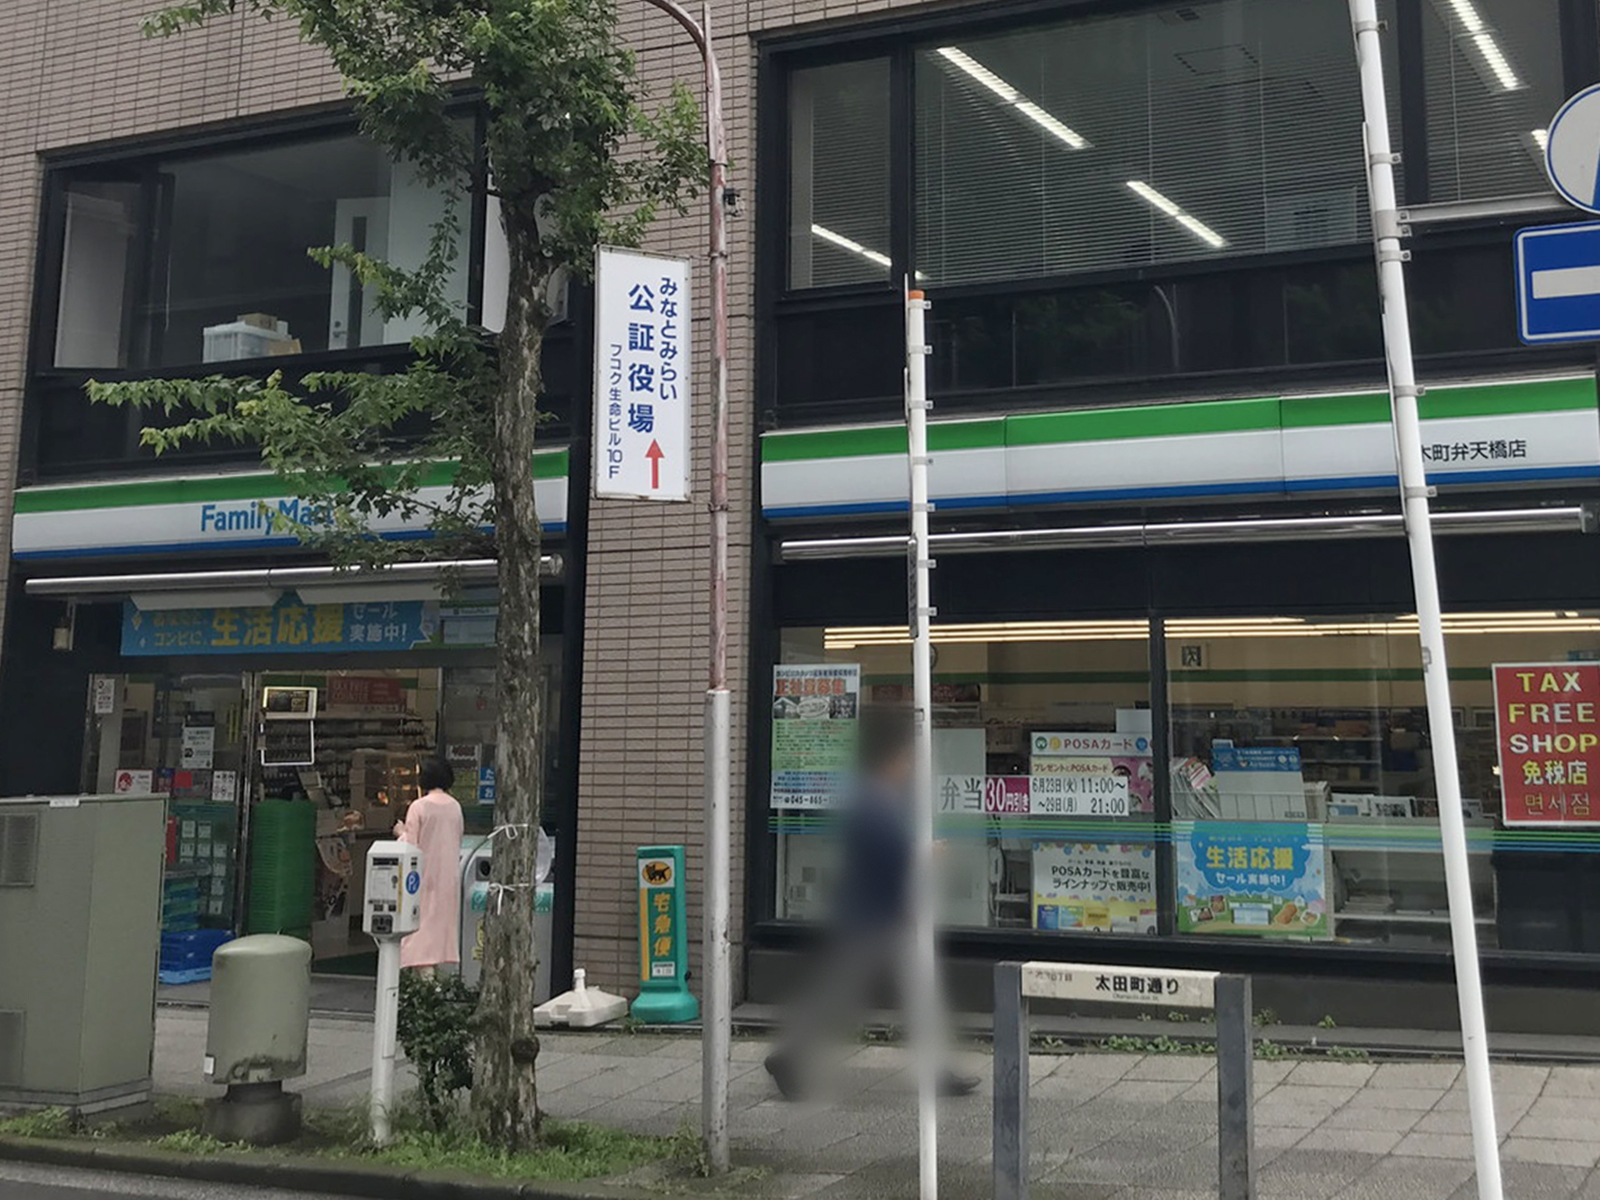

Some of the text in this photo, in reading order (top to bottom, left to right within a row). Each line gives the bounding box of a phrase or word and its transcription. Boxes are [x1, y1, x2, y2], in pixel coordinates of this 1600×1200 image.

[659, 276, 679, 401] みなとみらい
[627, 283, 655, 434] 公証役場
[211, 604, 345, 646] 生活応援
[1516, 671, 1583, 693] TAX
[1508, 702, 1597, 724] FREE
[1063, 738, 1134, 750] POSAカード
[1509, 733, 1599, 754] SHOP
[1522, 760, 1588, 785] 免税店
[941, 776, 983, 811] 弁当
[1090, 797, 1126, 814] 21:00
[1524, 792, 1590, 816] 면세점
[1205, 846, 1294, 870] 生活応援
[1095, 974, 1180, 995] 太田町通り
